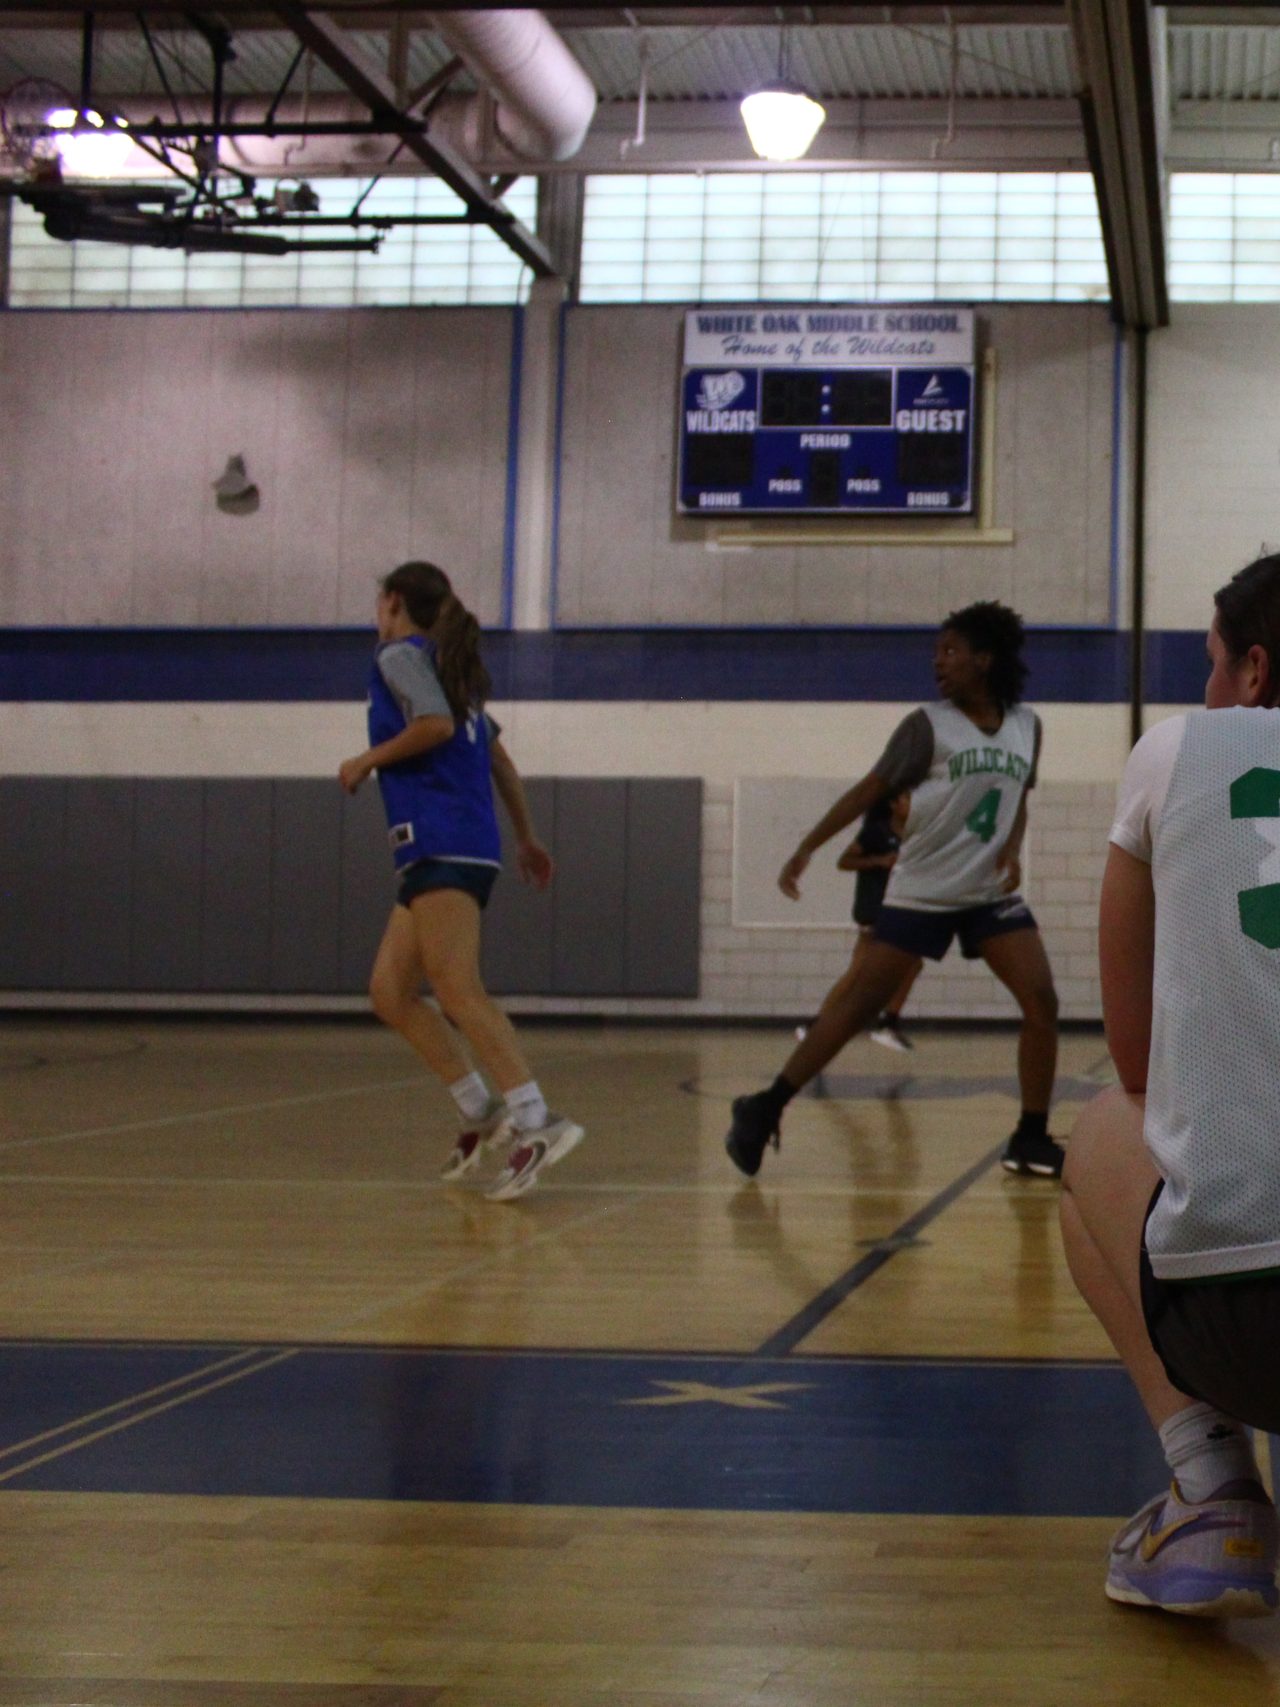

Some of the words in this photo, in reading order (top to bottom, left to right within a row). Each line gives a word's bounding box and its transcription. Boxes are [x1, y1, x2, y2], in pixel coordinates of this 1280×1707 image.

[698, 314, 757, 333] WHITE
[762, 314, 800, 333] OAK
[807, 314, 879, 333] MIDDLE
[885, 313, 962, 333] SCHOOL
[721, 334, 777, 356] Home
[785, 337, 805, 361] of
[811, 334, 840, 356] the
[847, 335, 935, 356] Wildcats
[686, 410, 757, 433] WILDCATS
[896, 409, 966, 432] GUEST
[800, 433, 851, 449] PERIOD
[768, 478, 803, 494] POSS
[846, 478, 881, 494] POSS
[699, 491, 742, 507] BONUS
[906, 491, 949, 507] BONUS
[948, 747, 1030, 783] WILDCAT
[965, 785, 1003, 844] 4
